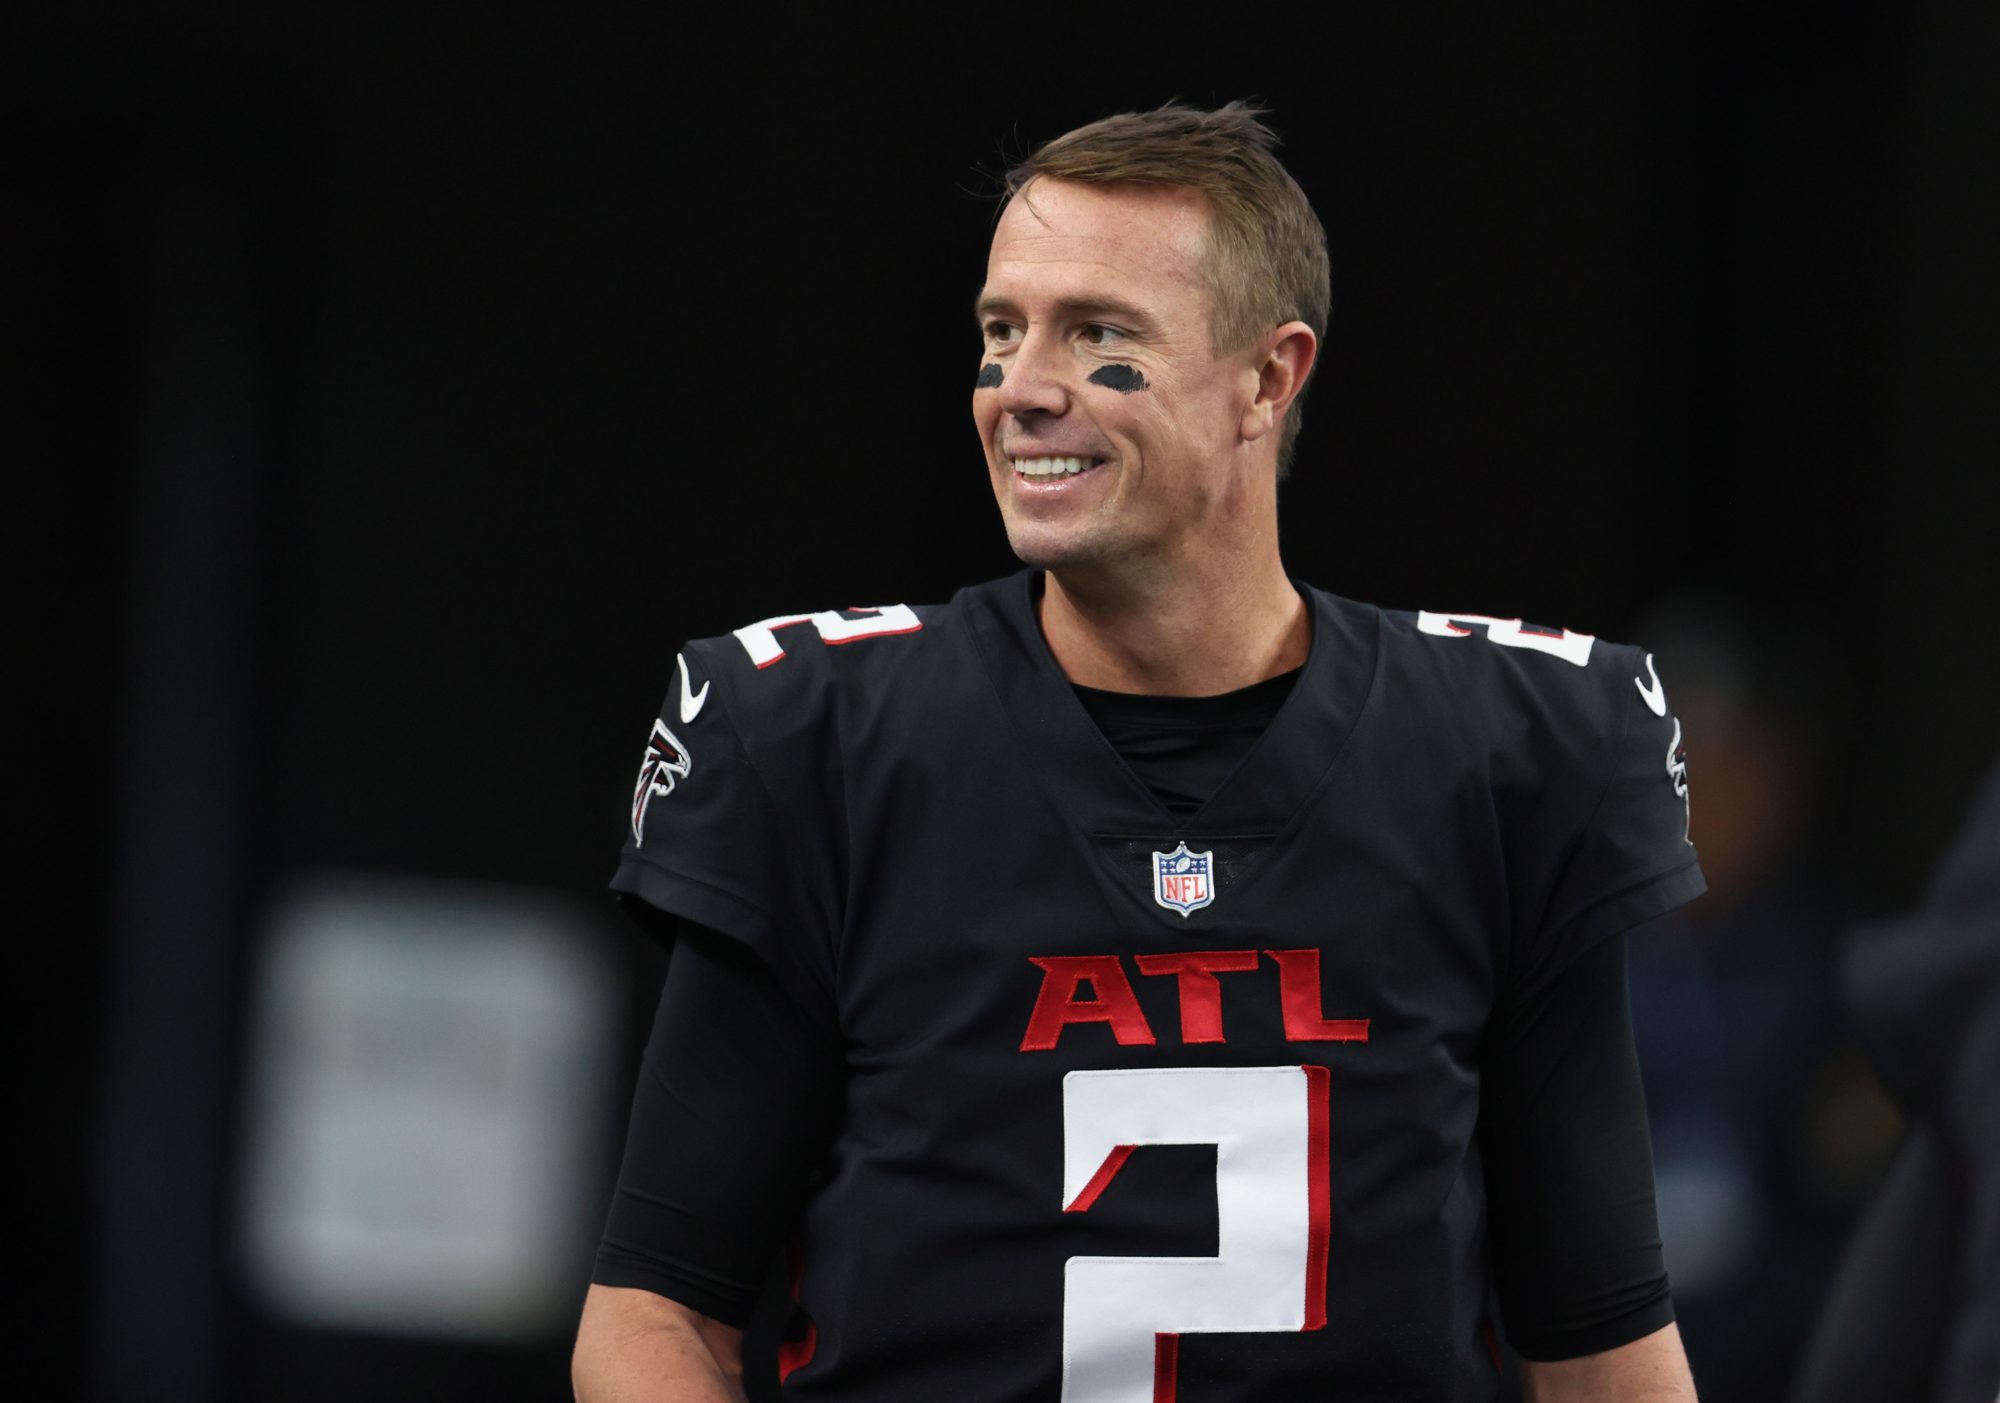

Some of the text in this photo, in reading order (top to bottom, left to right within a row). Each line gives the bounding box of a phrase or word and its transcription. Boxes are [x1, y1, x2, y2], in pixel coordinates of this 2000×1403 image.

[733, 603, 924, 670] 2
[1417, 610, 1595, 667] 2
[1164, 876, 1205, 903] NFL
[1020, 948, 1370, 1052] ATL
[1061, 1064, 1330, 1403] 2
